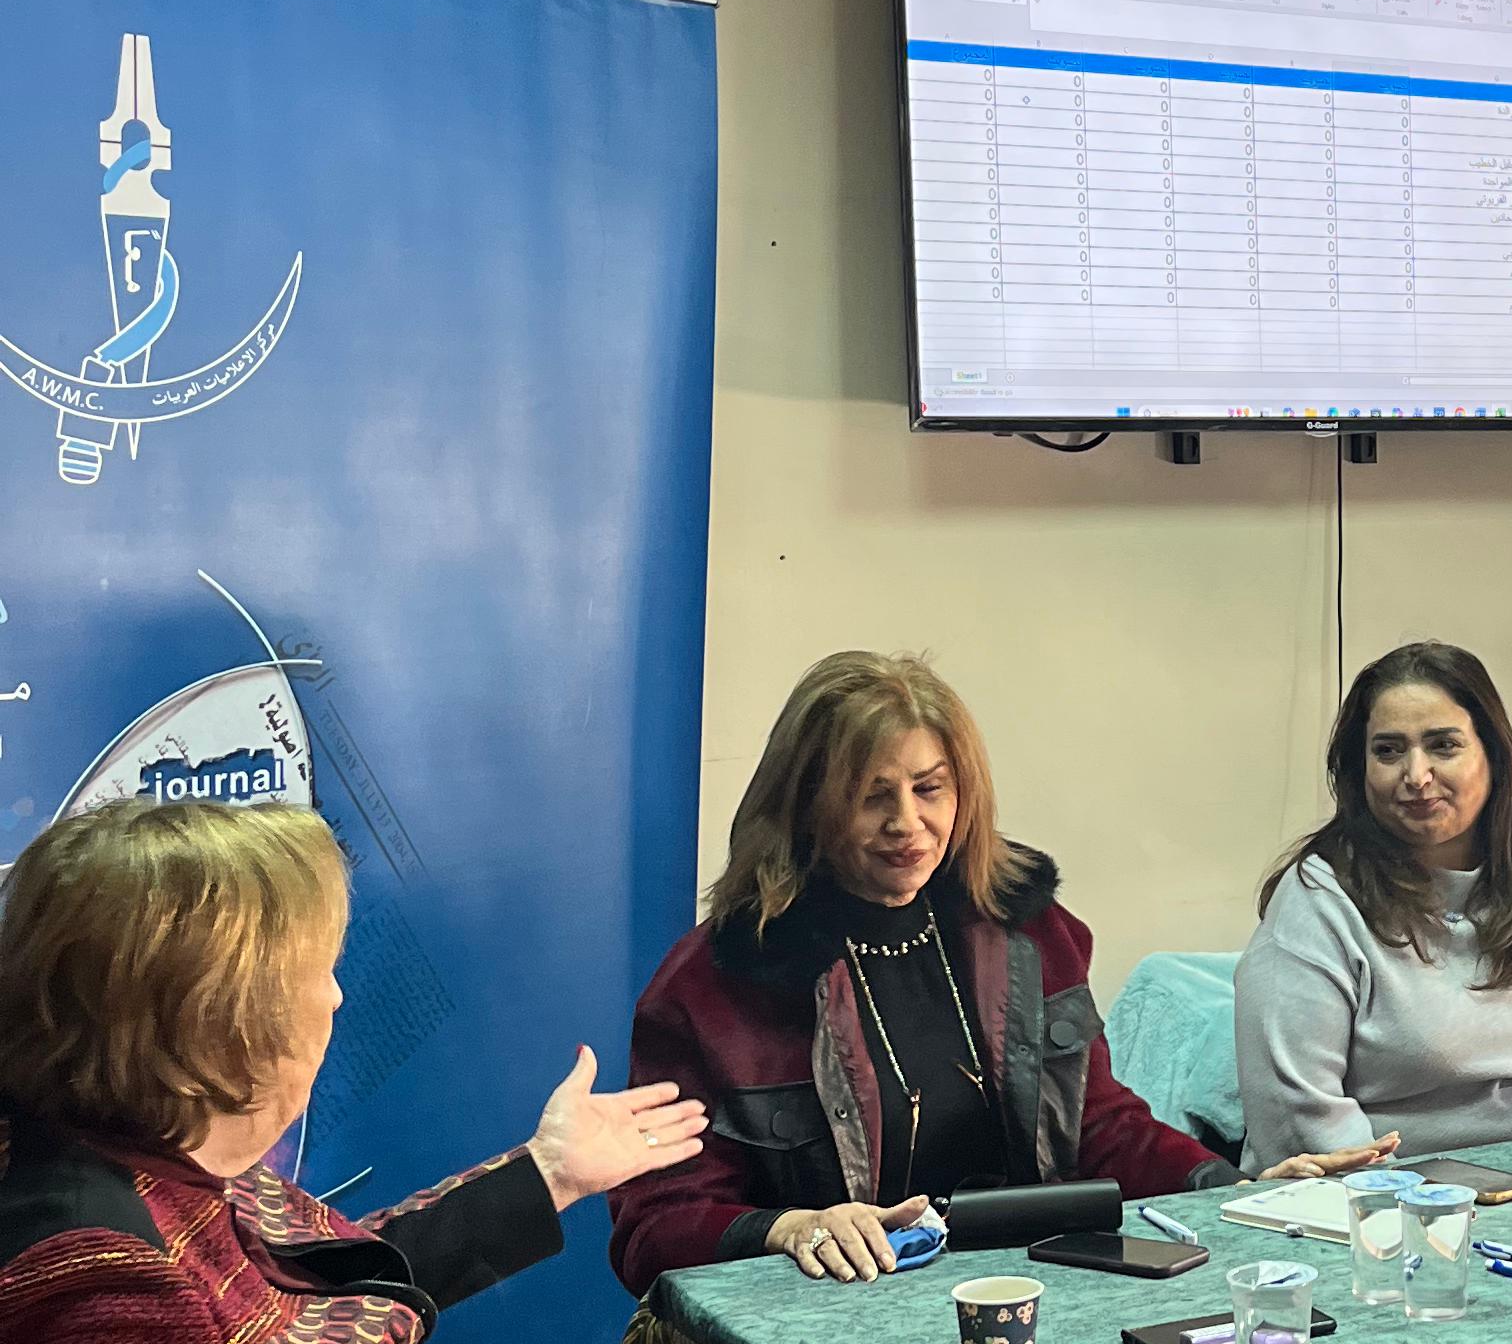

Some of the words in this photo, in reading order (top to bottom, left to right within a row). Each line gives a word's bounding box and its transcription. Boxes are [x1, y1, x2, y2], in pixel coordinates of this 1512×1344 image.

[984, 69, 991, 81] 0
[1074, 75, 1081, 87] 0
[1161, 82, 1167, 93] 0
[985, 89, 992, 101] 0
[1244, 88, 1251, 99] 0
[1324, 94, 1331, 104] 0
[1075, 95, 1082, 107] 0
[1161, 101, 1168, 112] 0
[1401, 99, 1408, 110] 0
[986, 109, 993, 120] 0
[1244, 107, 1251, 118] 0
[1325, 112, 1331, 123] 0
[1075, 114, 1082, 126] 0
[1162, 120, 1168, 131] 0
[1402, 117, 1408, 128] 0
[987, 128, 994, 140] 0
[1245, 125, 1252, 137] 0
[1325, 130, 1331, 142] 0
[1076, 134, 1083, 146] 0
[1162, 139, 1169, 150] 0
[1402, 135, 1408, 146] 0
[987, 148, 994, 160] 0
[1245, 144, 1252, 156] 0
[1325, 148, 1332, 160] 0
[1077, 153, 1084, 165] 0
[1163, 158, 1170, 170] 0
[1402, 153, 1409, 164] 0
[988, 168, 995, 180] 0
[1246, 163, 1252, 174] 0
[1326, 167, 1332, 178] 0
[1077, 173, 1084, 185] 0
[1403, 172, 1409, 182] 0
[1163, 177, 1170, 189] 0
[1247, 182, 1253, 193] 0
[989, 188, 996, 200] 0
[1327, 186, 1333, 197] 0
[1404, 190, 1410, 201] 0
[1078, 192, 1085, 204] 0
[1164, 196, 1171, 208] 0
[1247, 201, 1254, 212] 0
[1327, 204, 1333, 215] 0
[989, 208, 997, 220] 0
[1079, 212, 1086, 223] 0
[1404, 208, 1410, 219] 0
[1165, 216, 1172, 227] 0
[1248, 219, 1254, 230] 0
[990, 228, 997, 239] 0
[1328, 223, 1334, 234] 0
[1404, 226, 1411, 237] 0
[1079, 231, 1086, 243] 0
[1165, 235, 1172, 246] 0
[1248, 238, 1255, 249] 0
[1328, 241, 1334, 252] 0
[991, 248, 998, 259] 0
[1405, 244, 1411, 255] 0
[1080, 251, 1087, 262] 0
[1166, 254, 1173, 265] 0
[1249, 257, 1255, 268] 0
[1329, 260, 1335, 271] 0
[1406, 262, 1411, 273] 0
[992, 267, 999, 279] 0
[1081, 270, 1088, 281] 0
[1167, 273, 1173, 284] 0
[1249, 276, 1256, 287] 0
[1329, 278, 1336, 289] 0
[1406, 280, 1412, 291] 0
[993, 287, 1000, 298] 0
[1081, 289, 1088, 301] 0
[1167, 292, 1174, 303] 0
[1250, 294, 1256, 305] 0
[1330, 296, 1336, 307] 0
[1406, 298, 1412, 309] 0
[21, 367, 103, 410] A.W.M.C.
[152, 382, 201, 405] العربيات
[154, 759, 285, 803] journal
